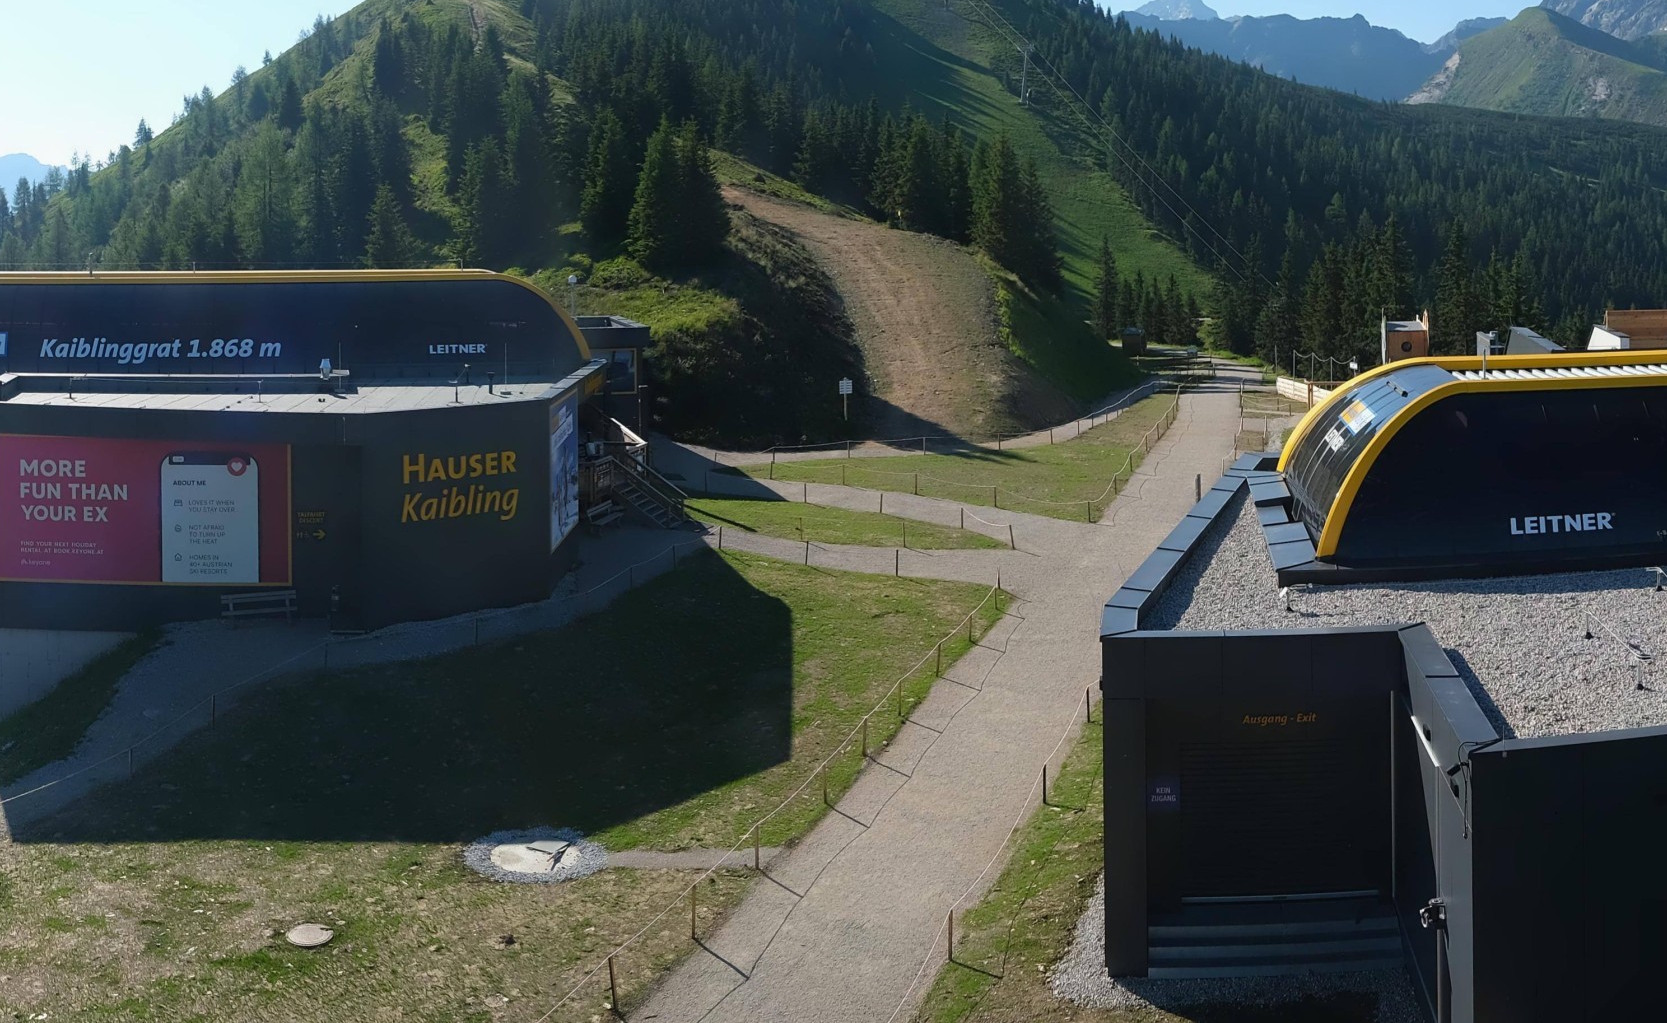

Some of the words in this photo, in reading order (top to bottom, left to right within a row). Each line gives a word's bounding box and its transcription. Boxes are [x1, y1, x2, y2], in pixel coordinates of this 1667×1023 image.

[39, 338, 182, 364] Kaiblinggrat
[187, 339, 254, 358] 1.868
[259, 342, 282, 358] m
[429, 343, 487, 355] LEITNER
[20, 459, 86, 477] MORE
[402, 450, 517, 484] HAUSER
[20, 482, 61, 499] FUN
[68, 483, 128, 500] THAN
[401, 485, 520, 523] Kaibling
[21, 505, 77, 521] YOUR
[83, 506, 108, 522] EX
[1510, 512, 1614, 535] LEITNER
[1242, 714, 1288, 726] Ausgang
[1296, 712, 1317, 723] Exit
[1151, 794, 1177, 802] ZUGANG
[1156, 786, 1171, 794] KEIN
